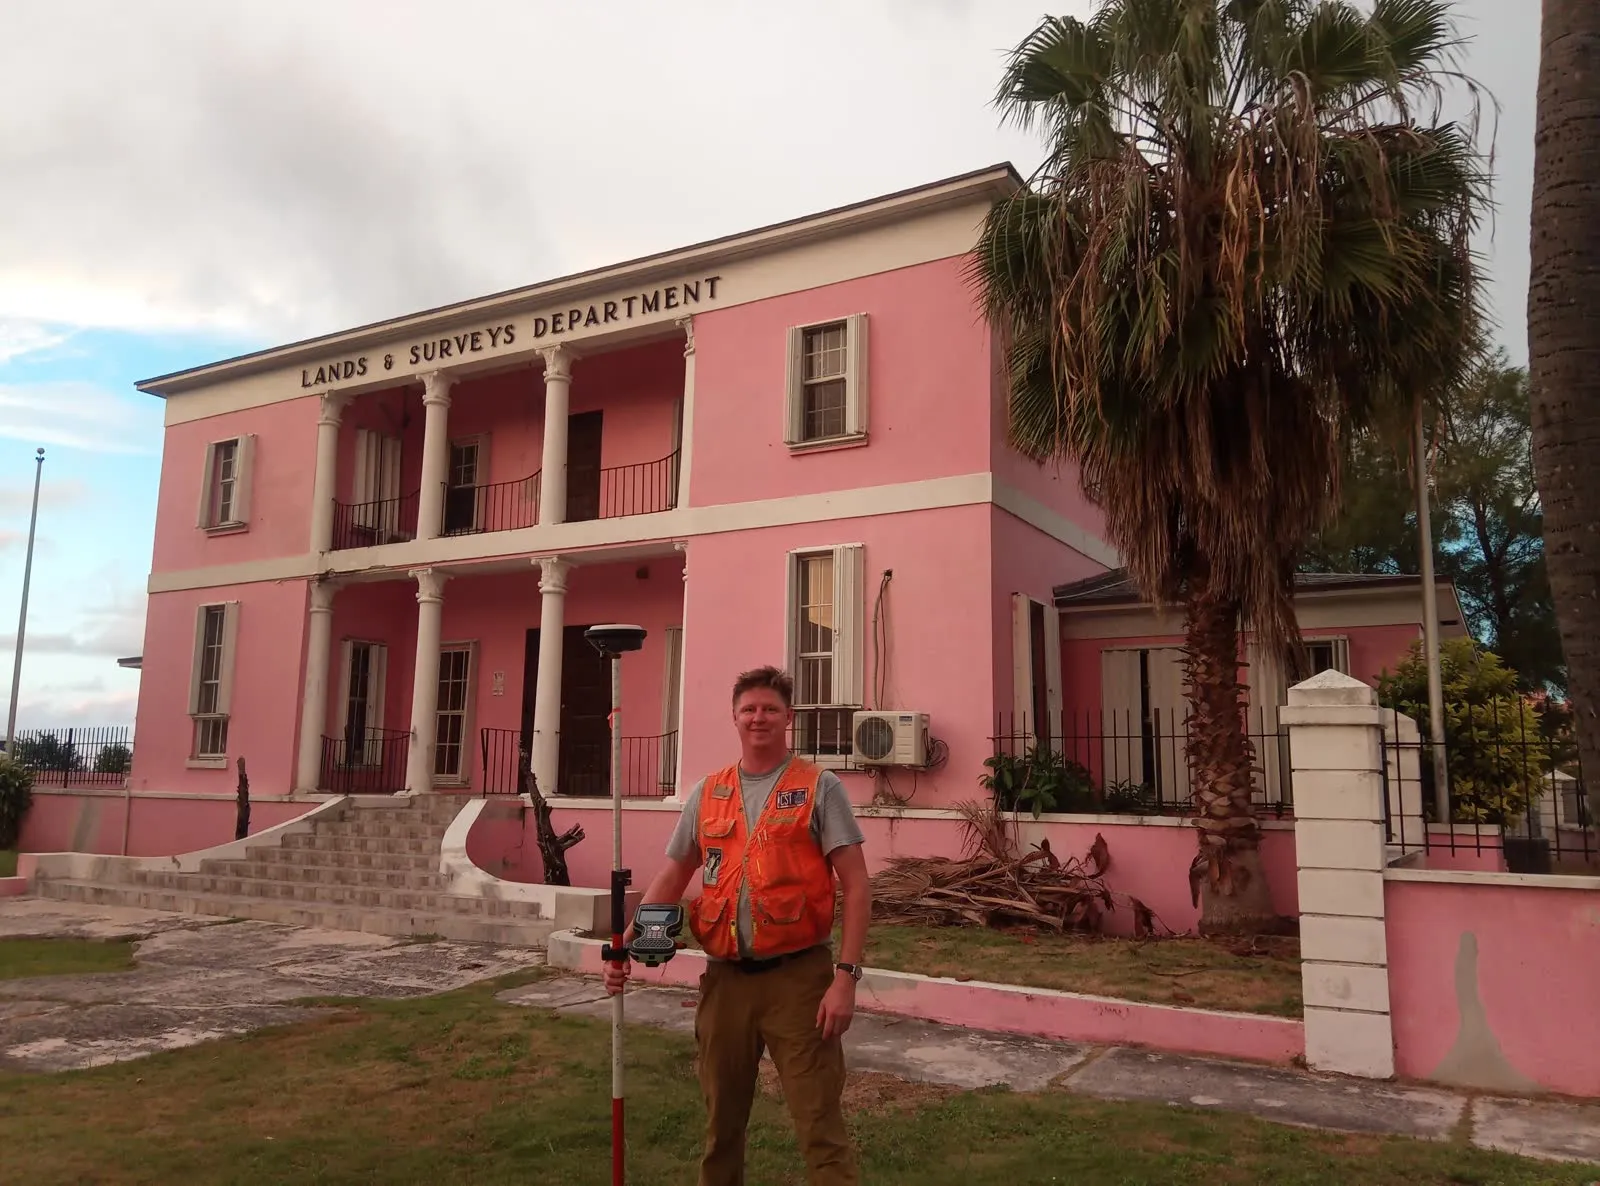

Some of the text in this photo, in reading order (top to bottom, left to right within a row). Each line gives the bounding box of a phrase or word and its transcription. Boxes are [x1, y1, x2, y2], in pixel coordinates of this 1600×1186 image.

[301, 276, 721, 387] LANDS & SURVEYS DEPARTMENT
